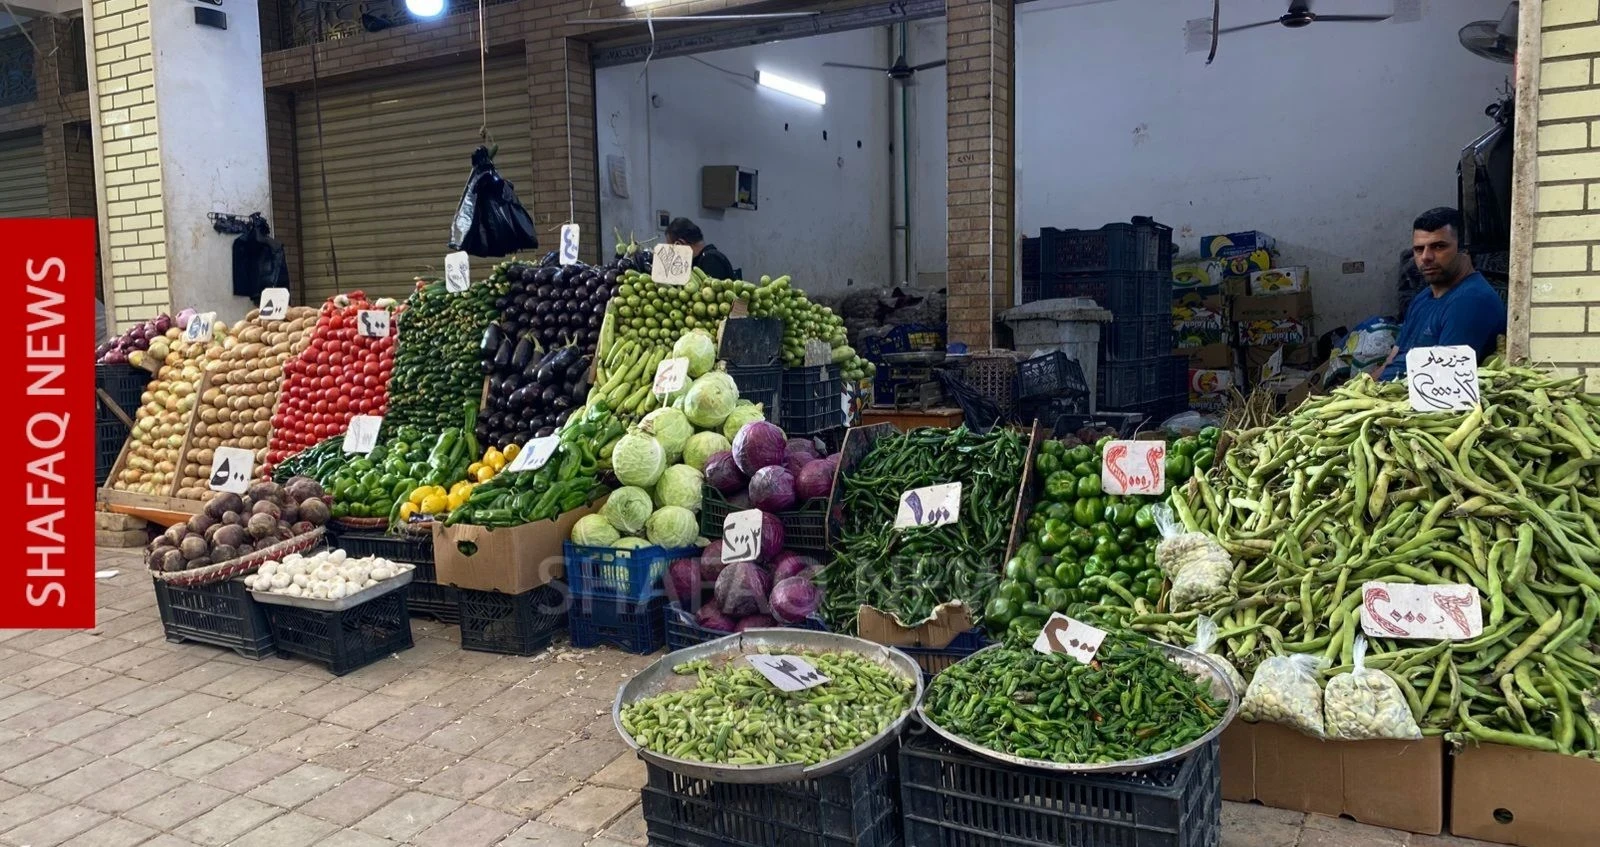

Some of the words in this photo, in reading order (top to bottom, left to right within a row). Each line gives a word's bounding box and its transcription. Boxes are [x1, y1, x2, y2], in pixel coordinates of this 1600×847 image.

[260, 299, 281, 316] ٥٠٠
[361, 311, 385, 336] ٤٠٠
[1421, 350, 1444, 368] حلو
[1441, 355, 1470, 368] جزر
[520, 445, 545, 470] ١٠٠٠
[211, 457, 244, 486] ٥٠٠
[905, 490, 950, 526] ١٠٠٠
[1044, 617, 1095, 654] ٢٠٠٠
